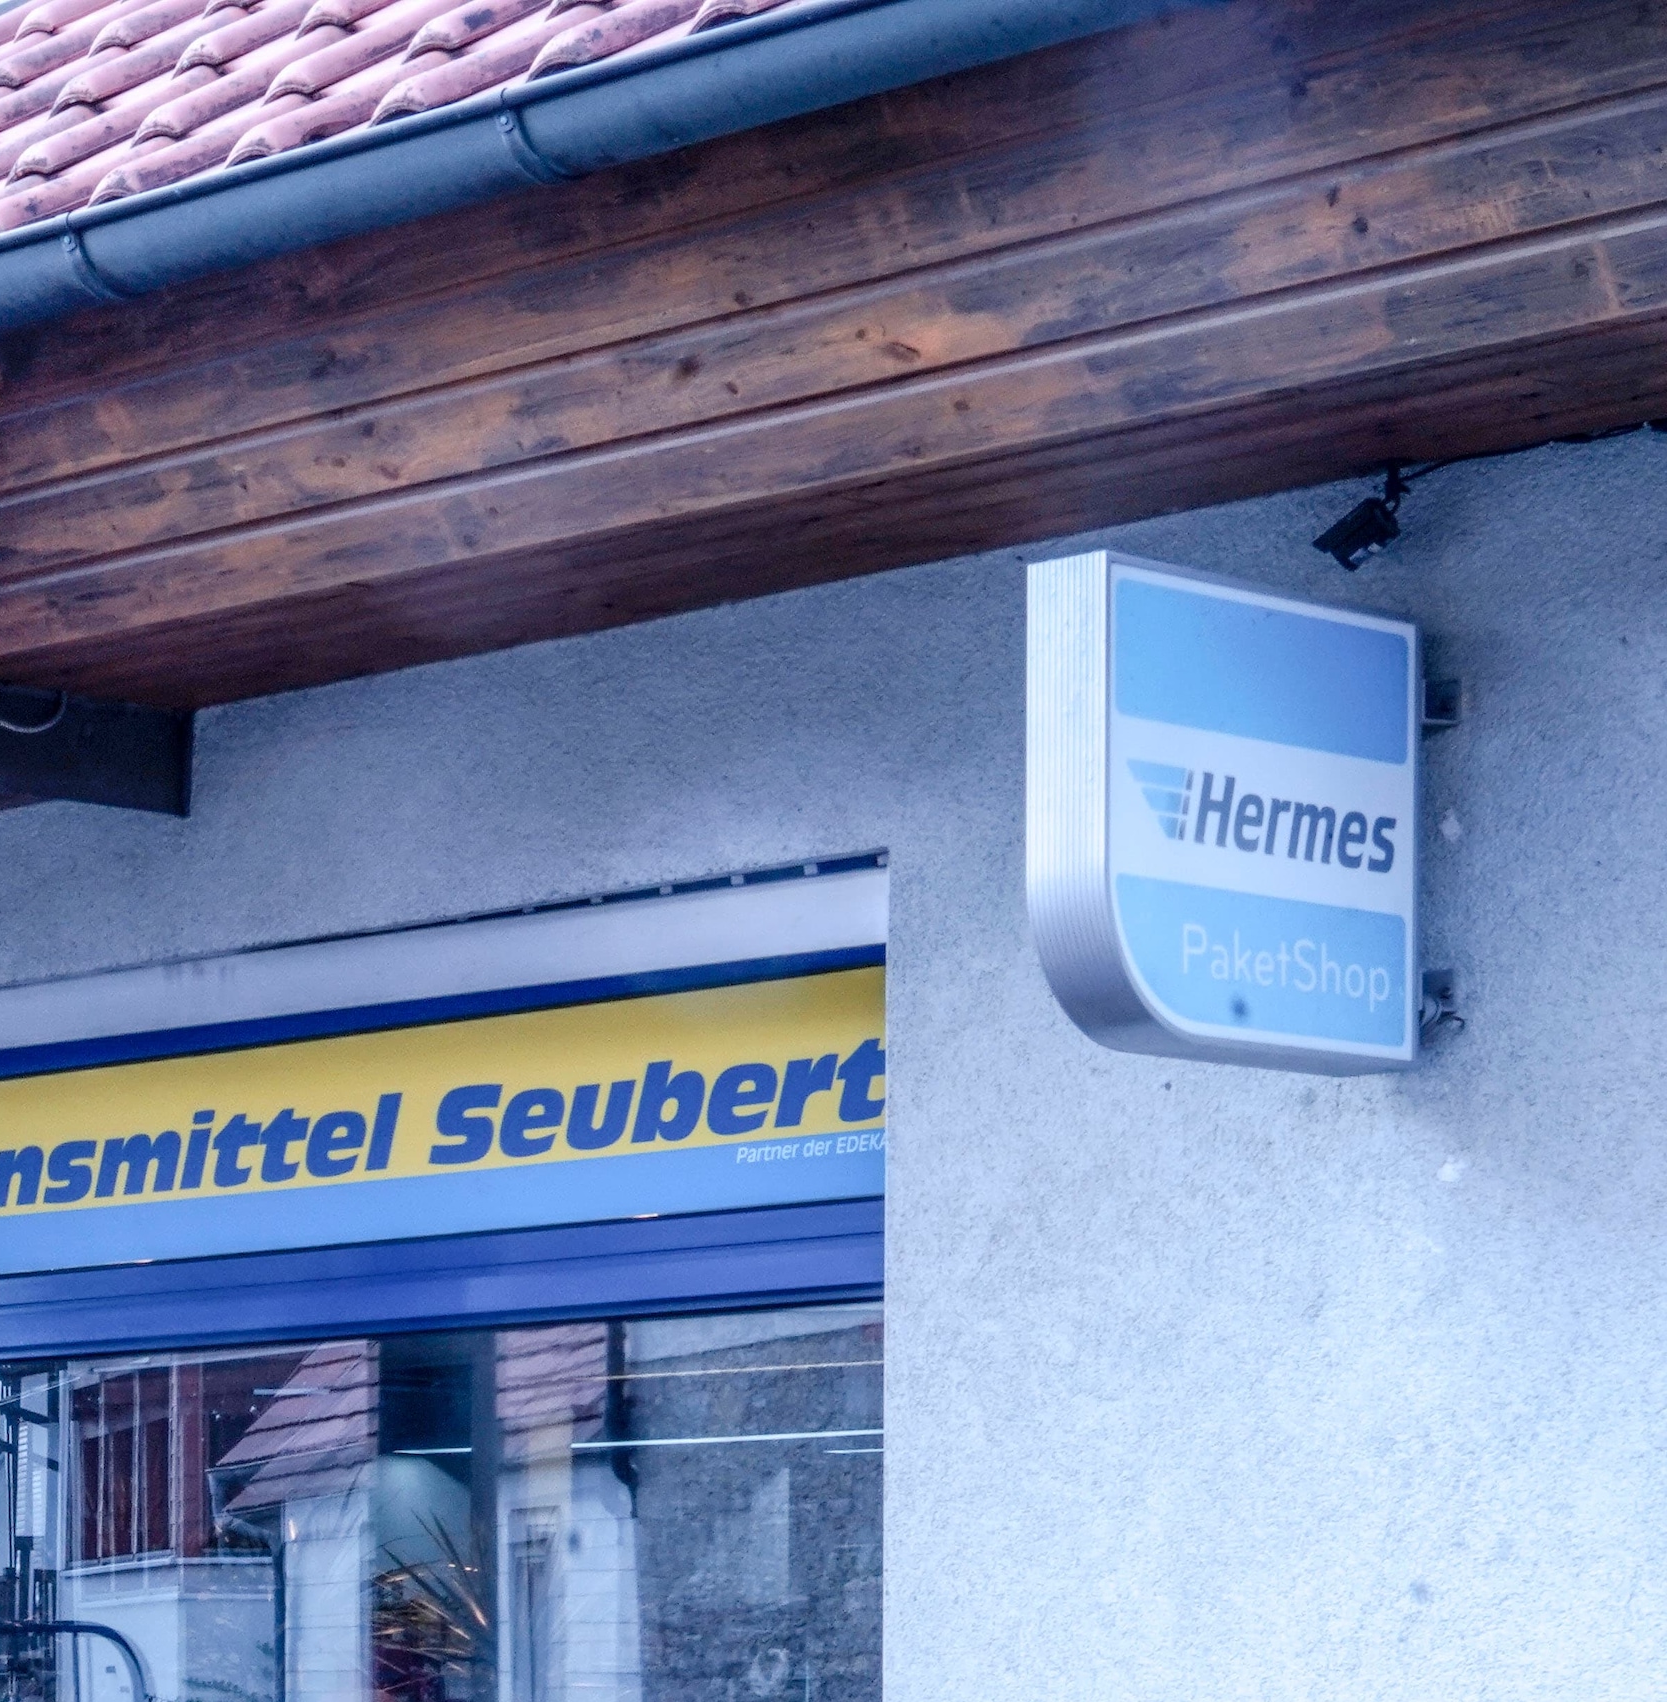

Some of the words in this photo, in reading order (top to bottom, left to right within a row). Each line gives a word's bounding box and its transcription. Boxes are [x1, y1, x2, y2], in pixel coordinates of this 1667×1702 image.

[1194, 771, 1397, 874] Hermes
[1181, 922, 1391, 1013] PaketShop
[427, 1037, 886, 1165] Seubert
[736, 1143, 800, 1164] Partner
[803, 1139, 833, 1158] der
